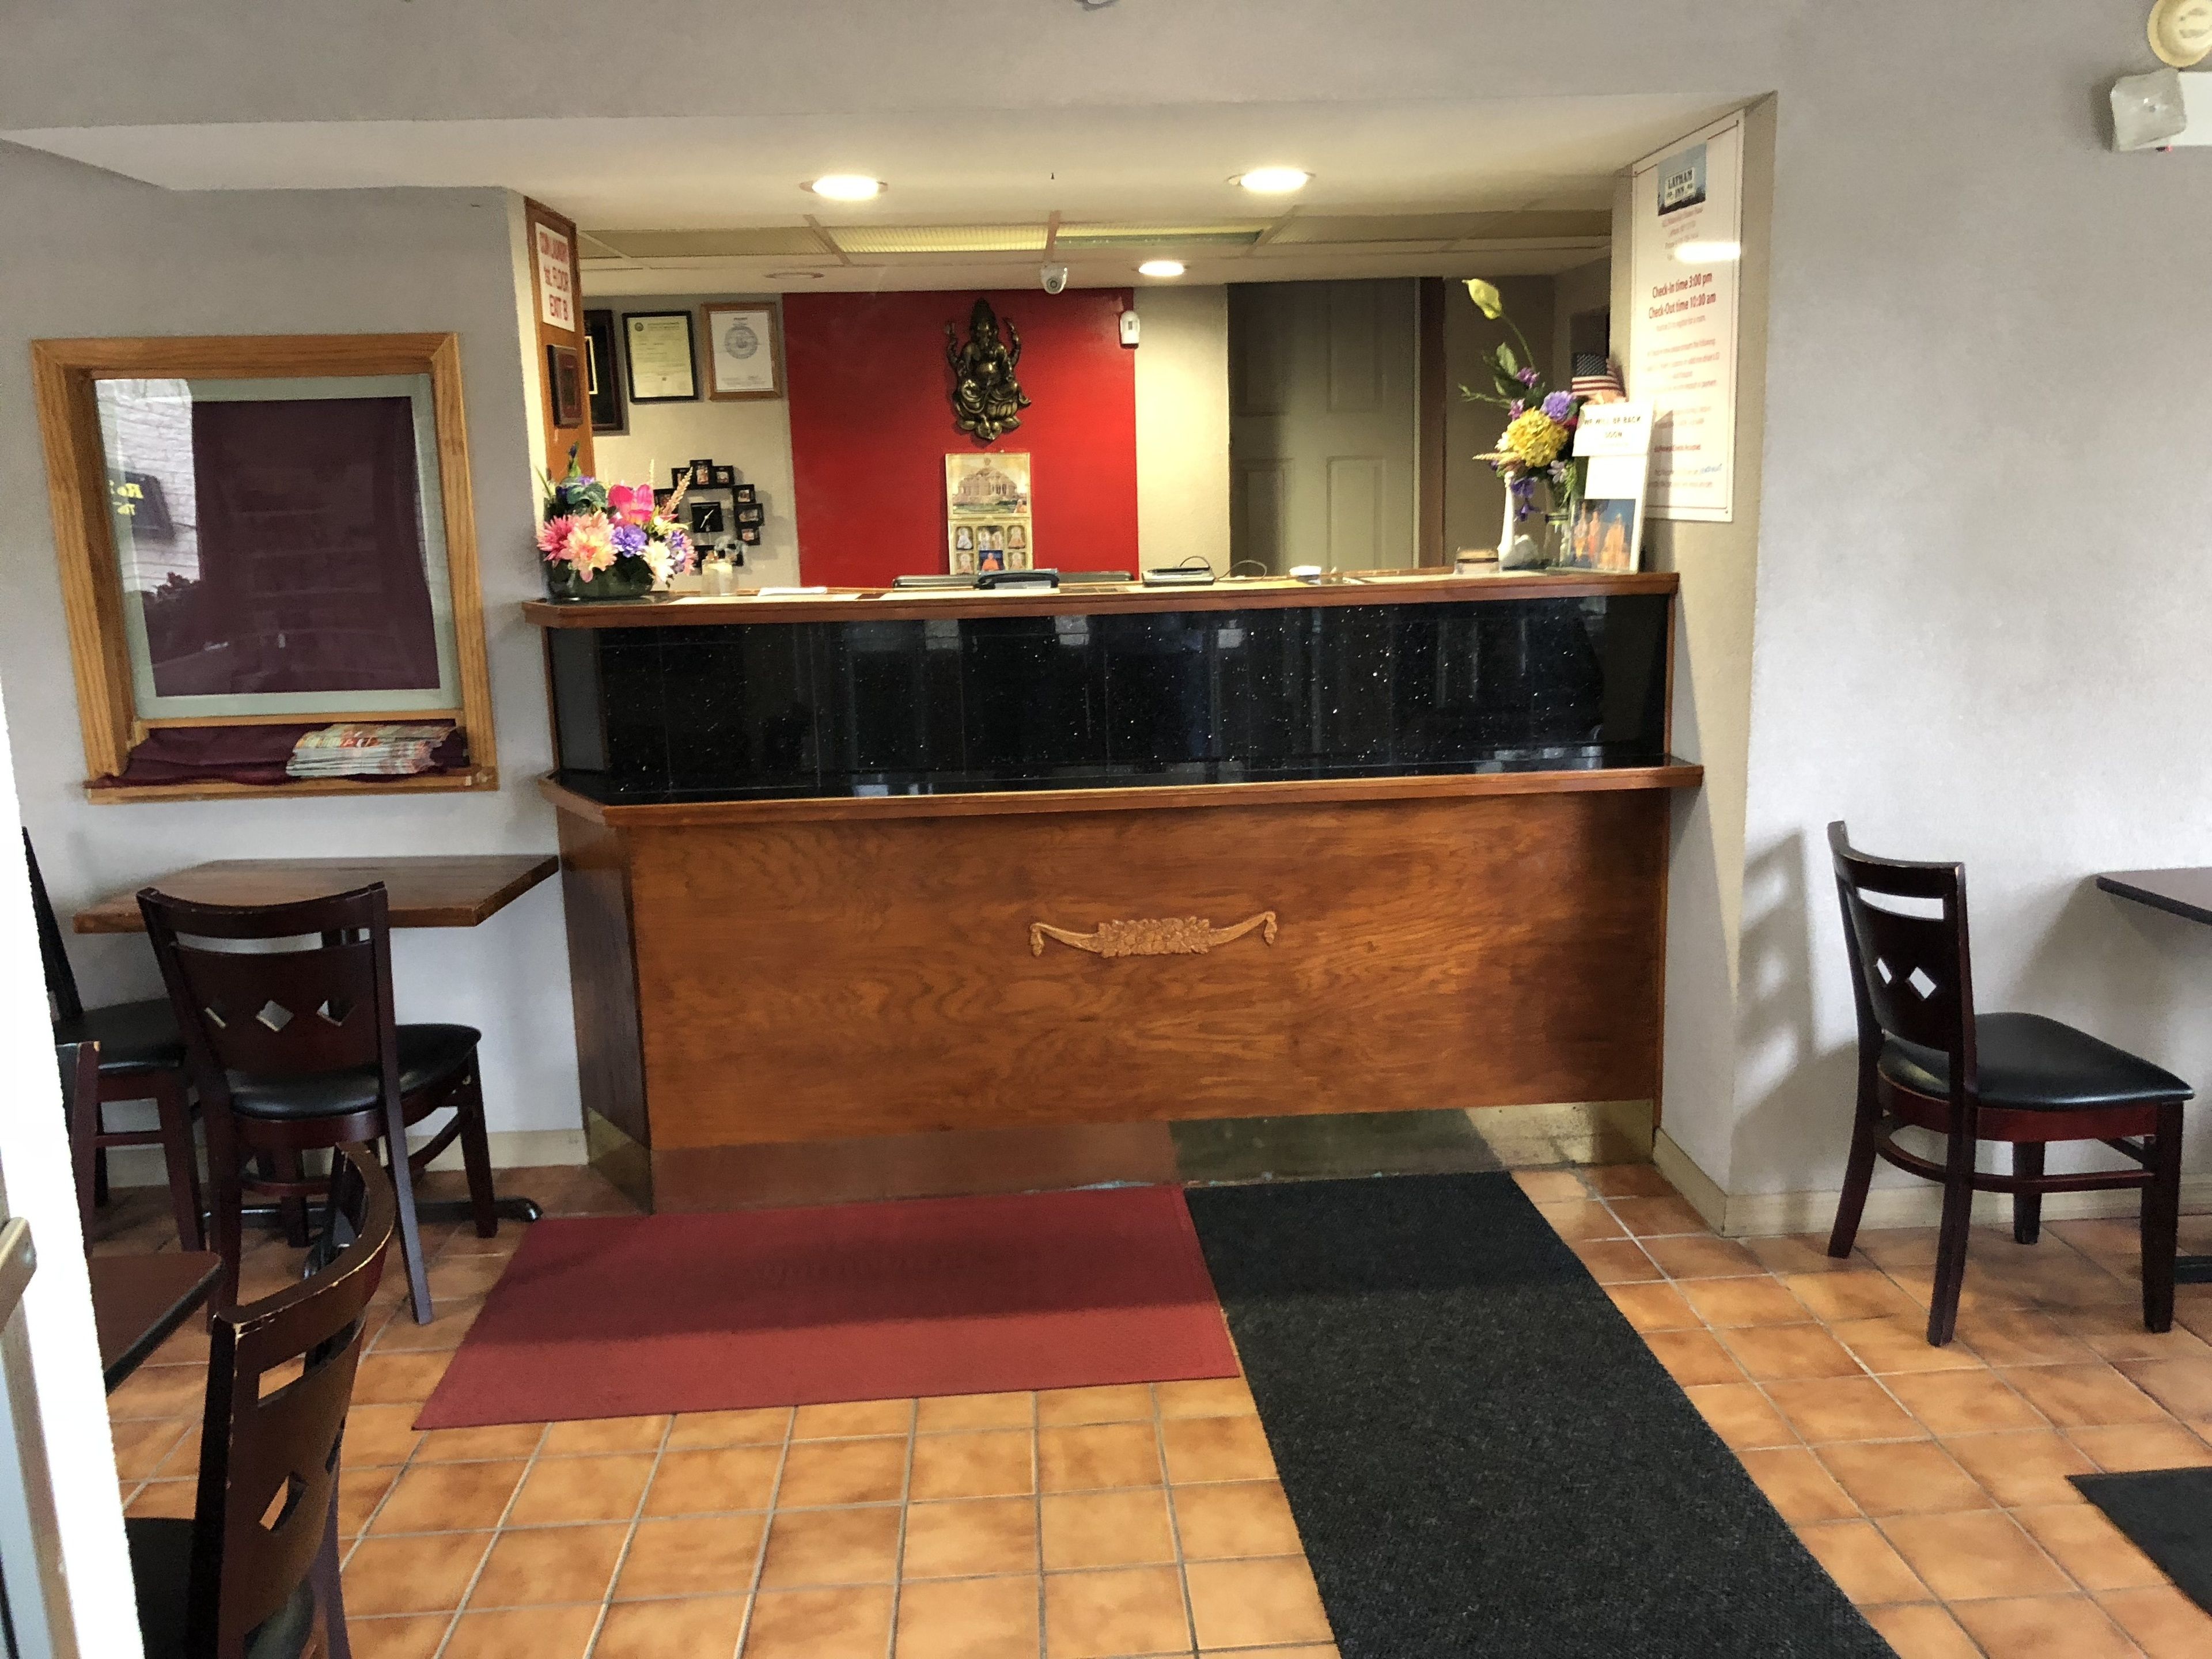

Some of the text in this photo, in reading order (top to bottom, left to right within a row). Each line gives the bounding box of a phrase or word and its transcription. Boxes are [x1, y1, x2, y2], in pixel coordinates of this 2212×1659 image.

[1668, 169, 1692, 190] LATHAM
[1675, 185, 1684, 199] INN
[1652, 272, 1713, 298] Check-In time 3:00 pm
[1649, 302, 1675, 319] Check-Out
[1676, 299, 1688, 312] time
[1707, 293, 1716, 304] am
